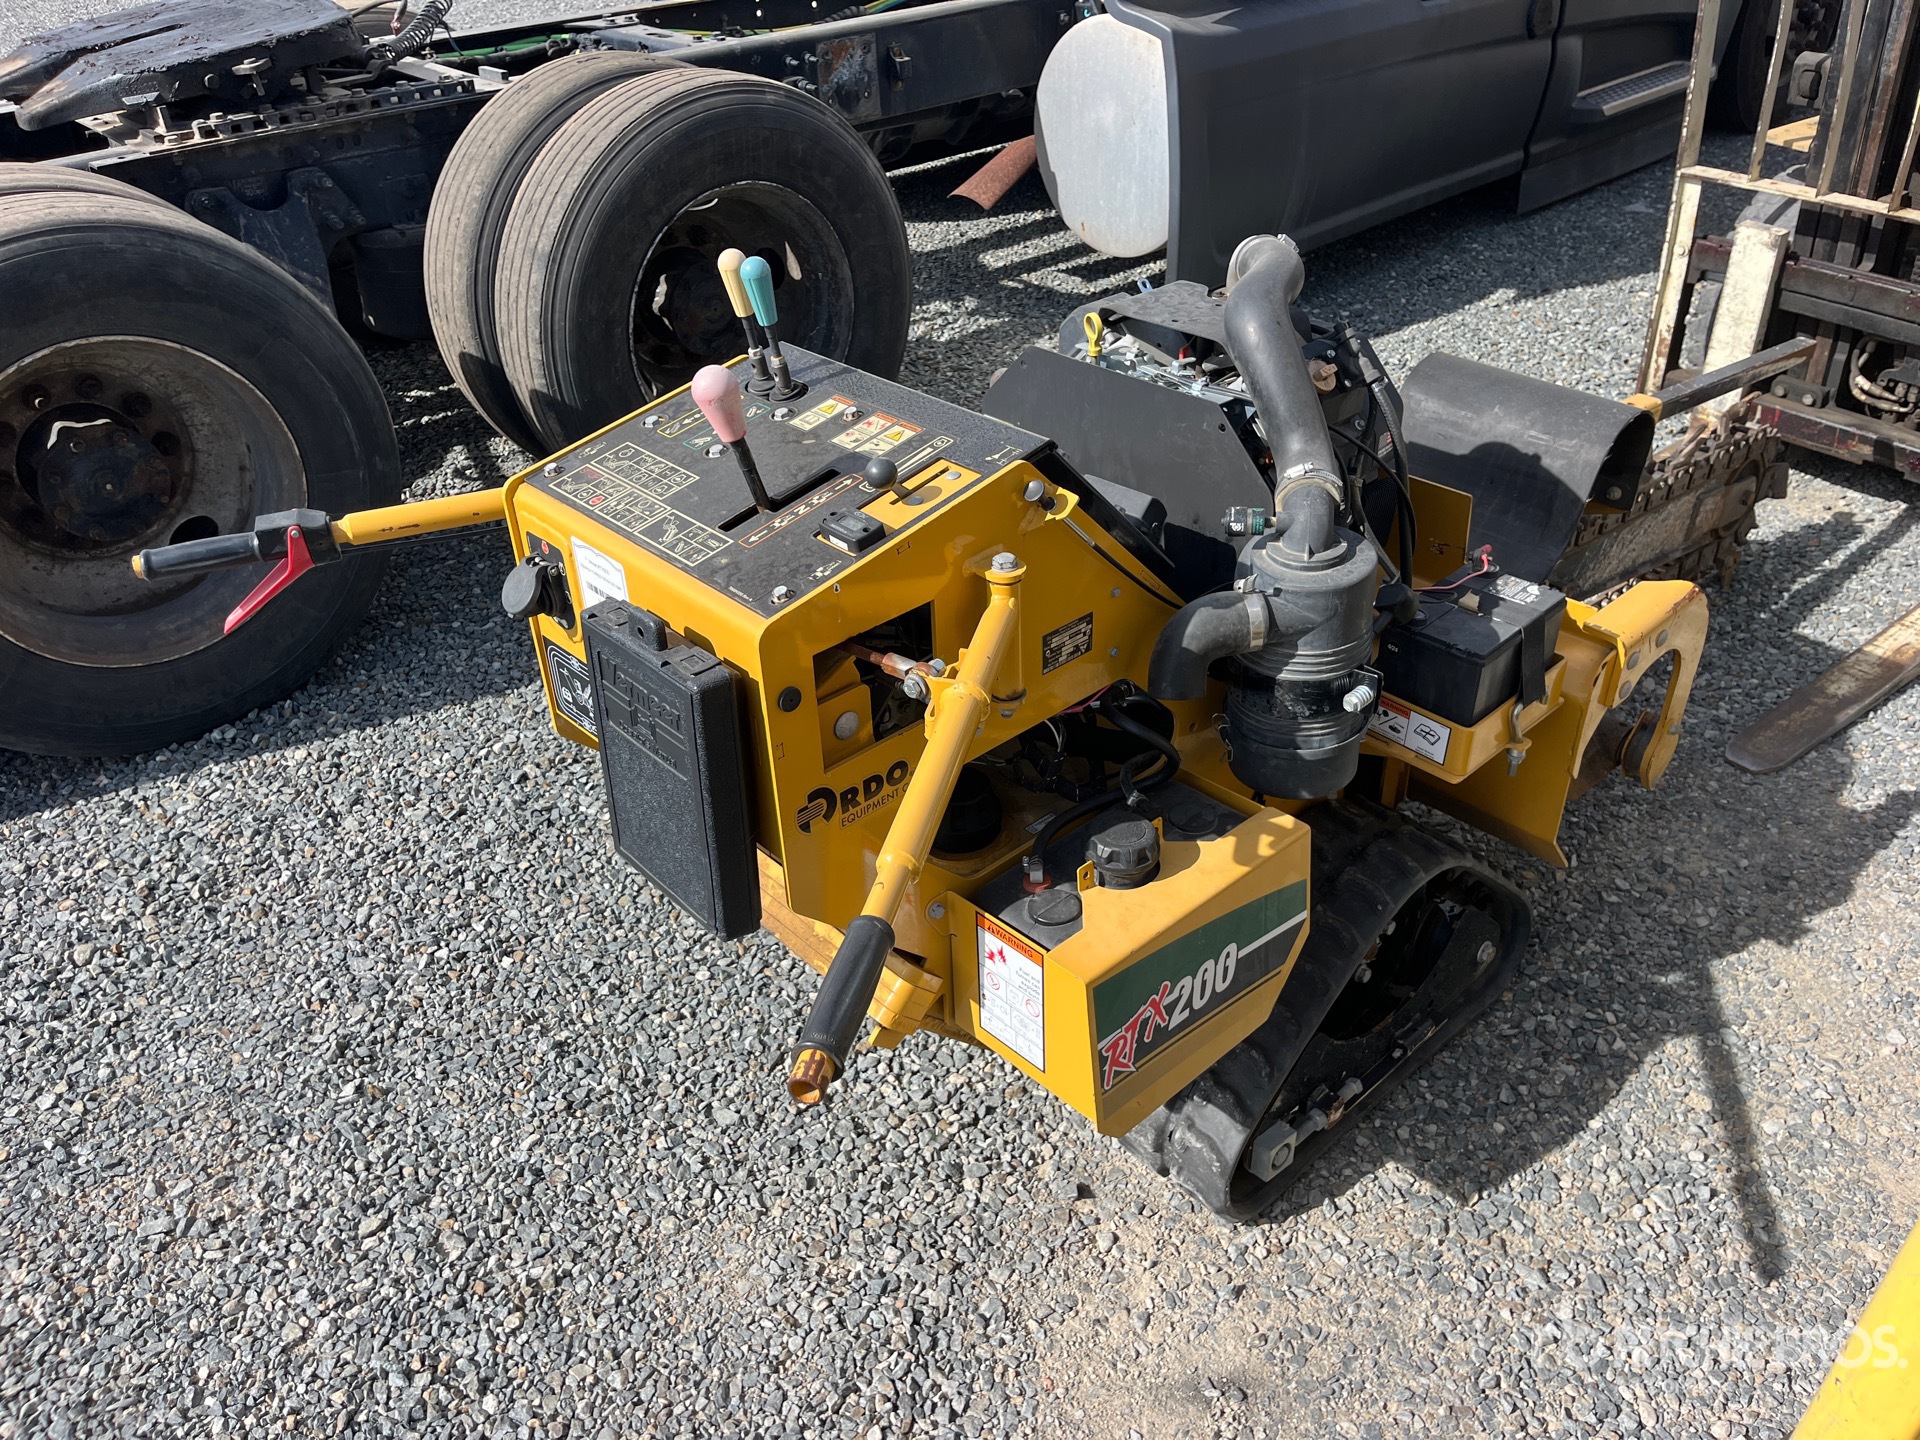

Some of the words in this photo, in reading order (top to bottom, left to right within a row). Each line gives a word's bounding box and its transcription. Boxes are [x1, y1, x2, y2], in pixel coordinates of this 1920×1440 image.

[599, 652, 681, 731] Vermeer
[1381, 698, 1409, 716] WARNING
[842, 788, 900, 828] EQUIPMENT
[994, 927, 1033, 958] WARNING
